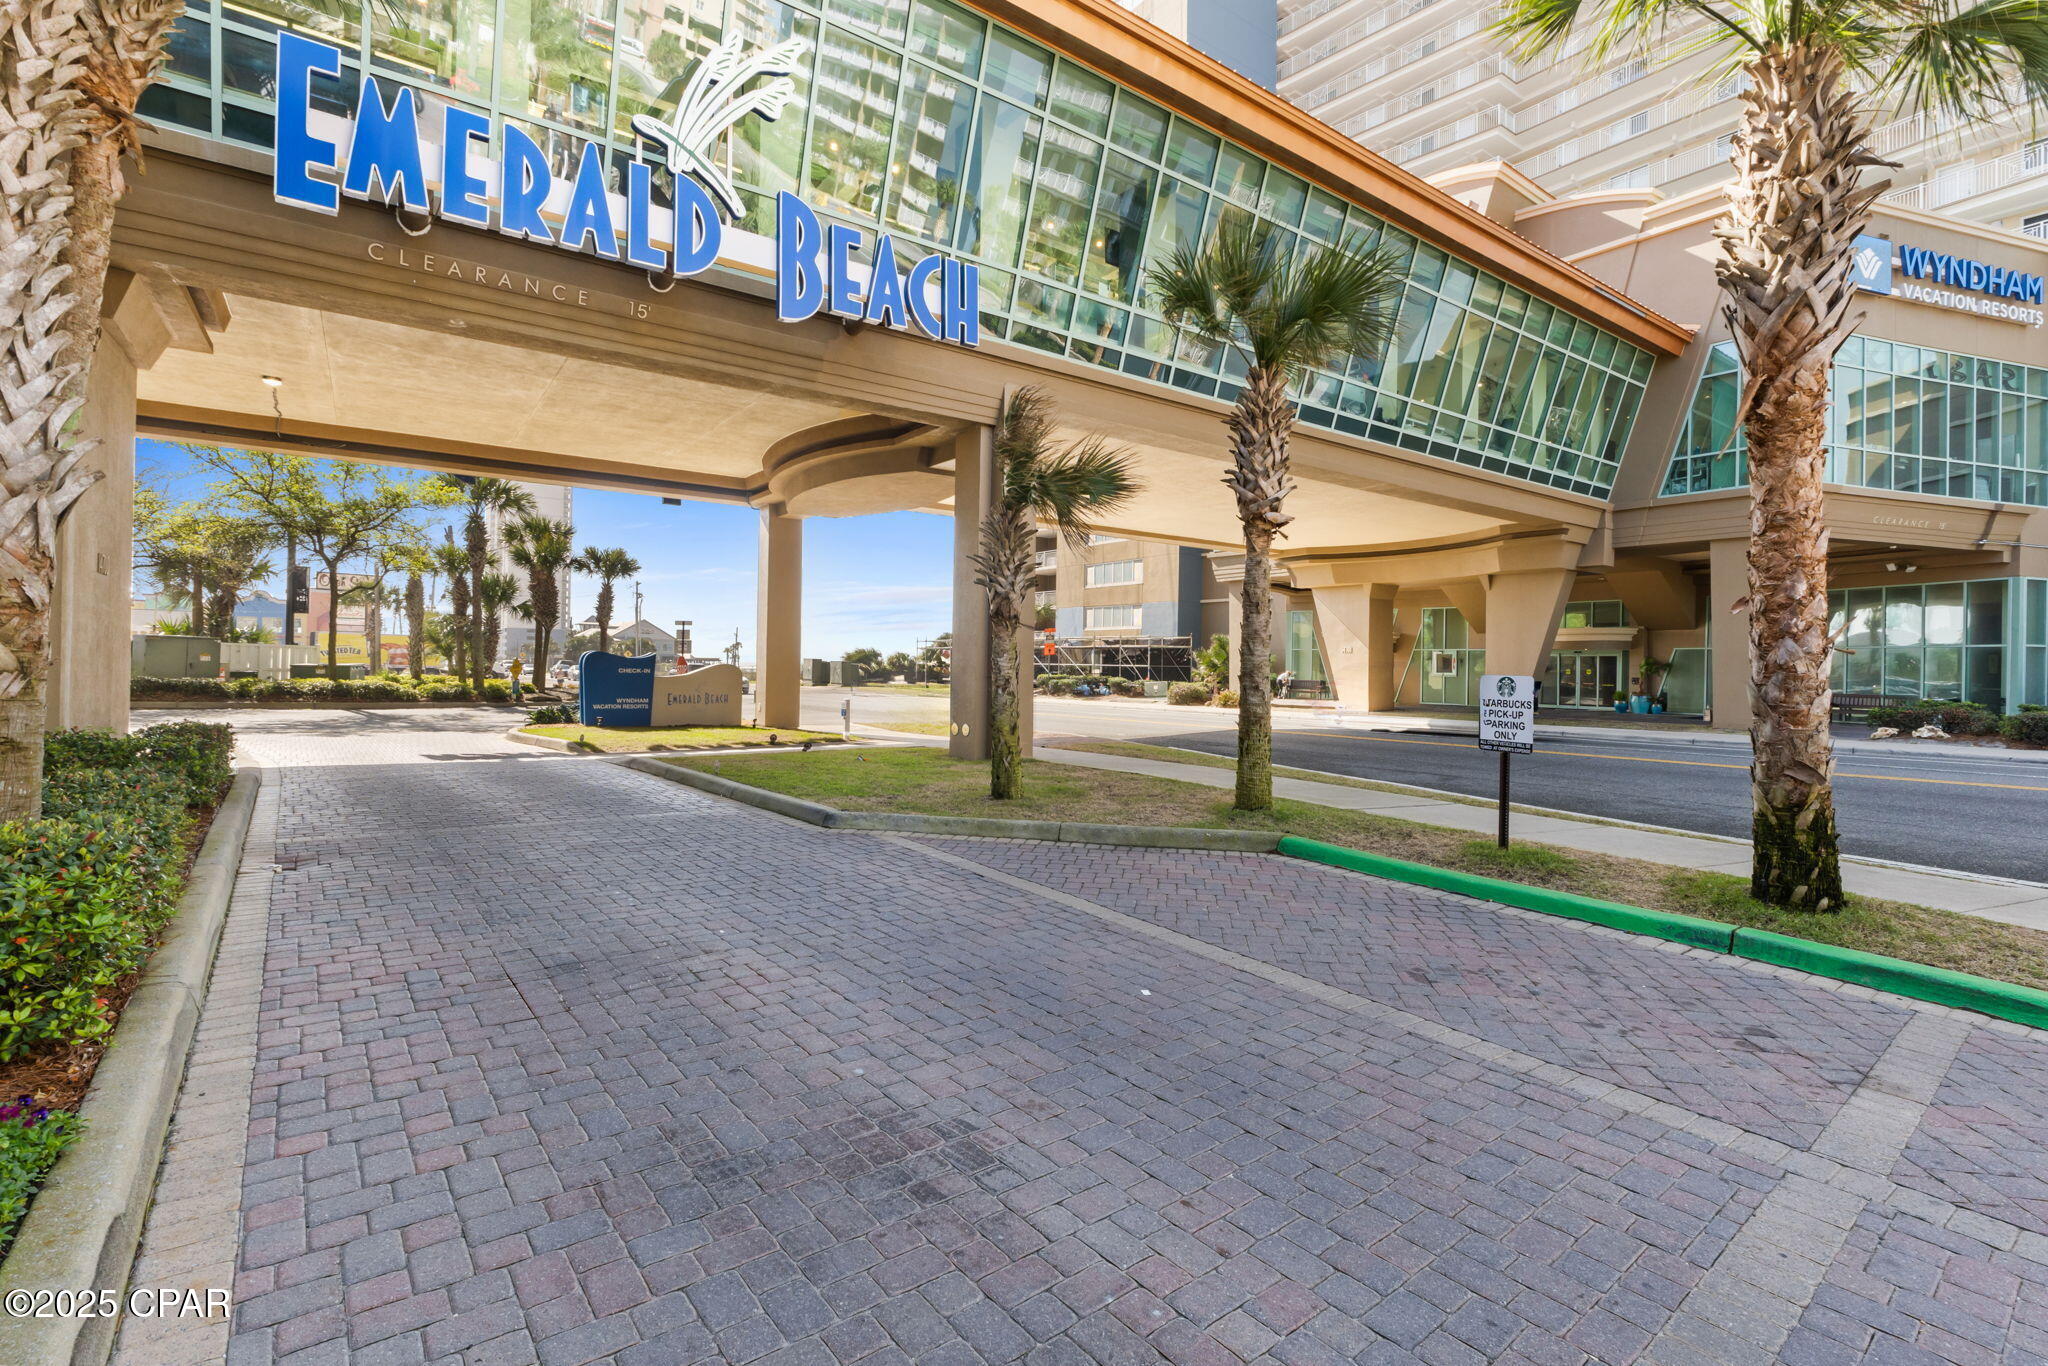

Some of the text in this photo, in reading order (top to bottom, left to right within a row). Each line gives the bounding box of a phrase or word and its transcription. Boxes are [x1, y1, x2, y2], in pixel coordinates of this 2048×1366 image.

[274, 30, 980, 348] EMERALD BEACH
[368, 242, 589, 307] CLEARANCE
[1900, 244, 2044, 305] WYNDHAM
[1903, 283, 2044, 326] VACATION RESORTS
[1872, 515, 1930, 529] CLEARANCE
[667, 692, 729, 706] EMERALD BEACH
[1488, 709, 1524, 719] PICK-UP
[1494, 730, 1518, 740] ONLY
